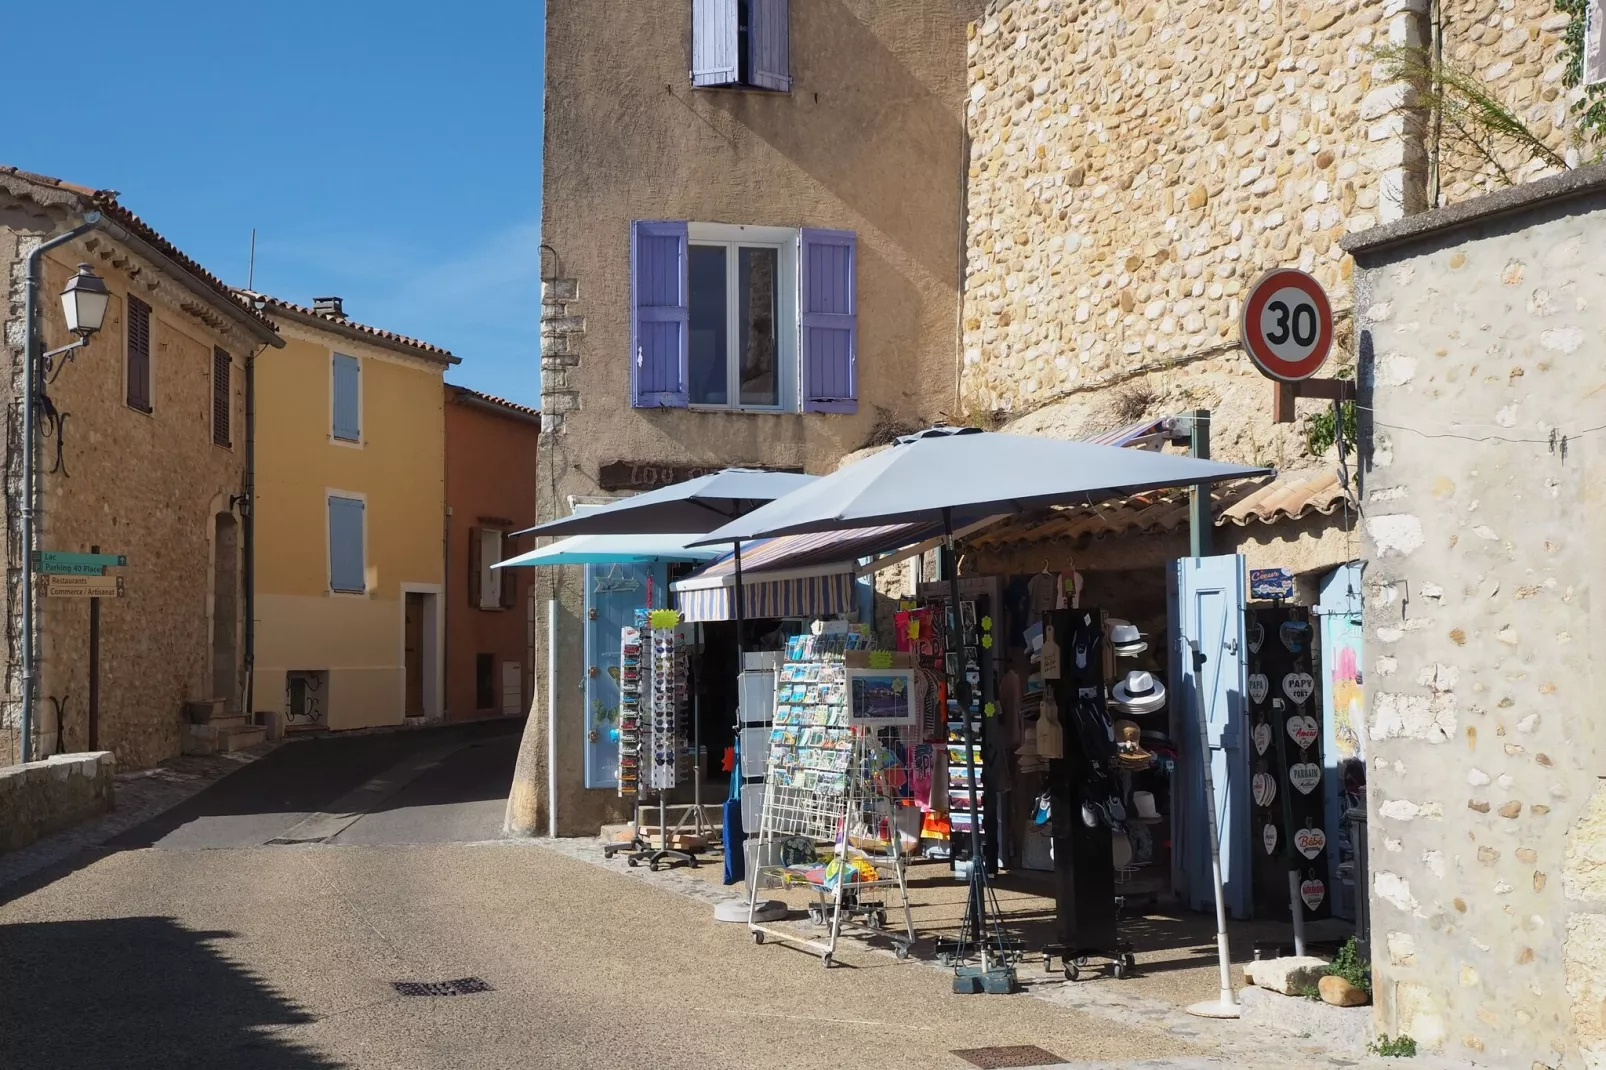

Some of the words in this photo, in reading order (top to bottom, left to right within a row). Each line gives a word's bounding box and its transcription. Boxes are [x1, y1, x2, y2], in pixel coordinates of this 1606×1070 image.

[1266, 300, 1317, 347] 30
[44, 553, 57, 561] Lac
[45, 563, 72, 574] Parking
[52, 577, 87, 585] Restaurants
[50, 587, 83, 596] Commerce
[88, 588, 115, 596] Artisanat
[1288, 679, 1313, 688] PAPY
[1296, 727, 1317, 737] Amour
[1298, 835, 1324, 848] Bébé
